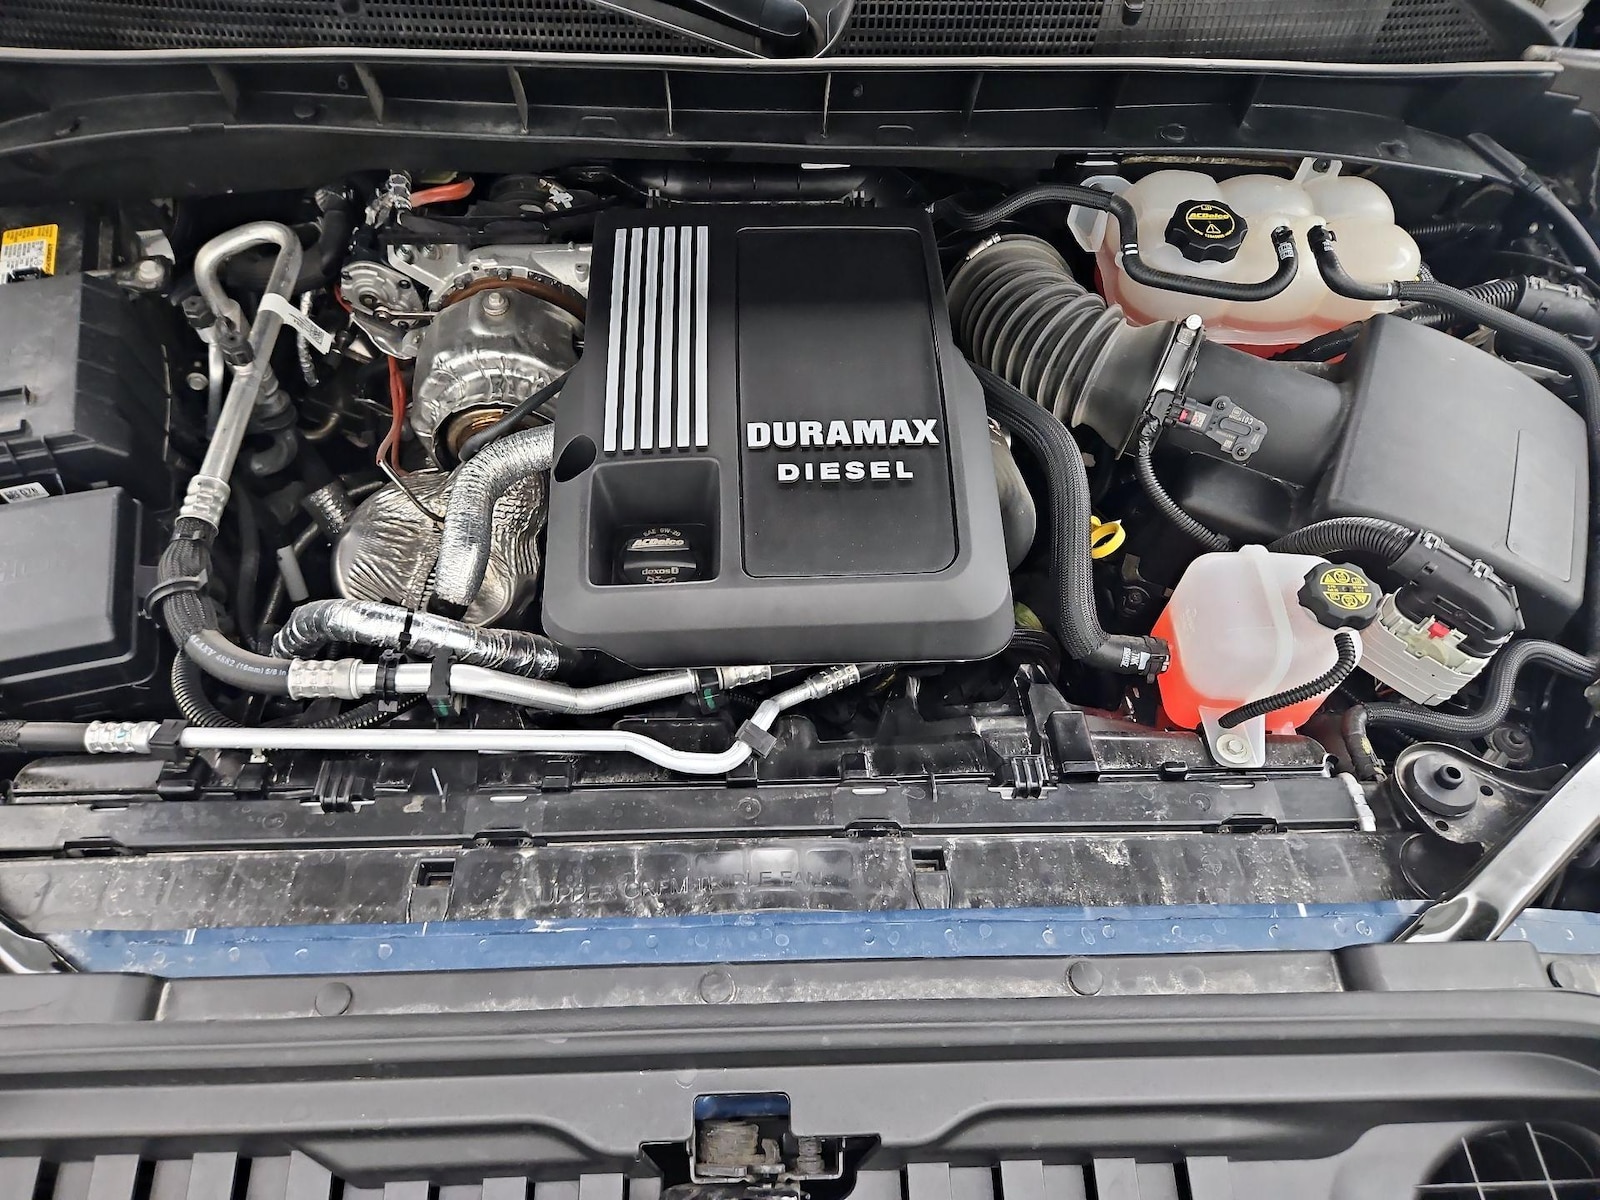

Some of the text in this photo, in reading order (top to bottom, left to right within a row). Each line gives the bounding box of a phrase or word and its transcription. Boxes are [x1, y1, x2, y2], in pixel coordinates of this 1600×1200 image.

[746, 419, 940, 449] DURAMAX
[776, 460, 914, 483] DIESEL
[631, 538, 685, 549] ACDelco
